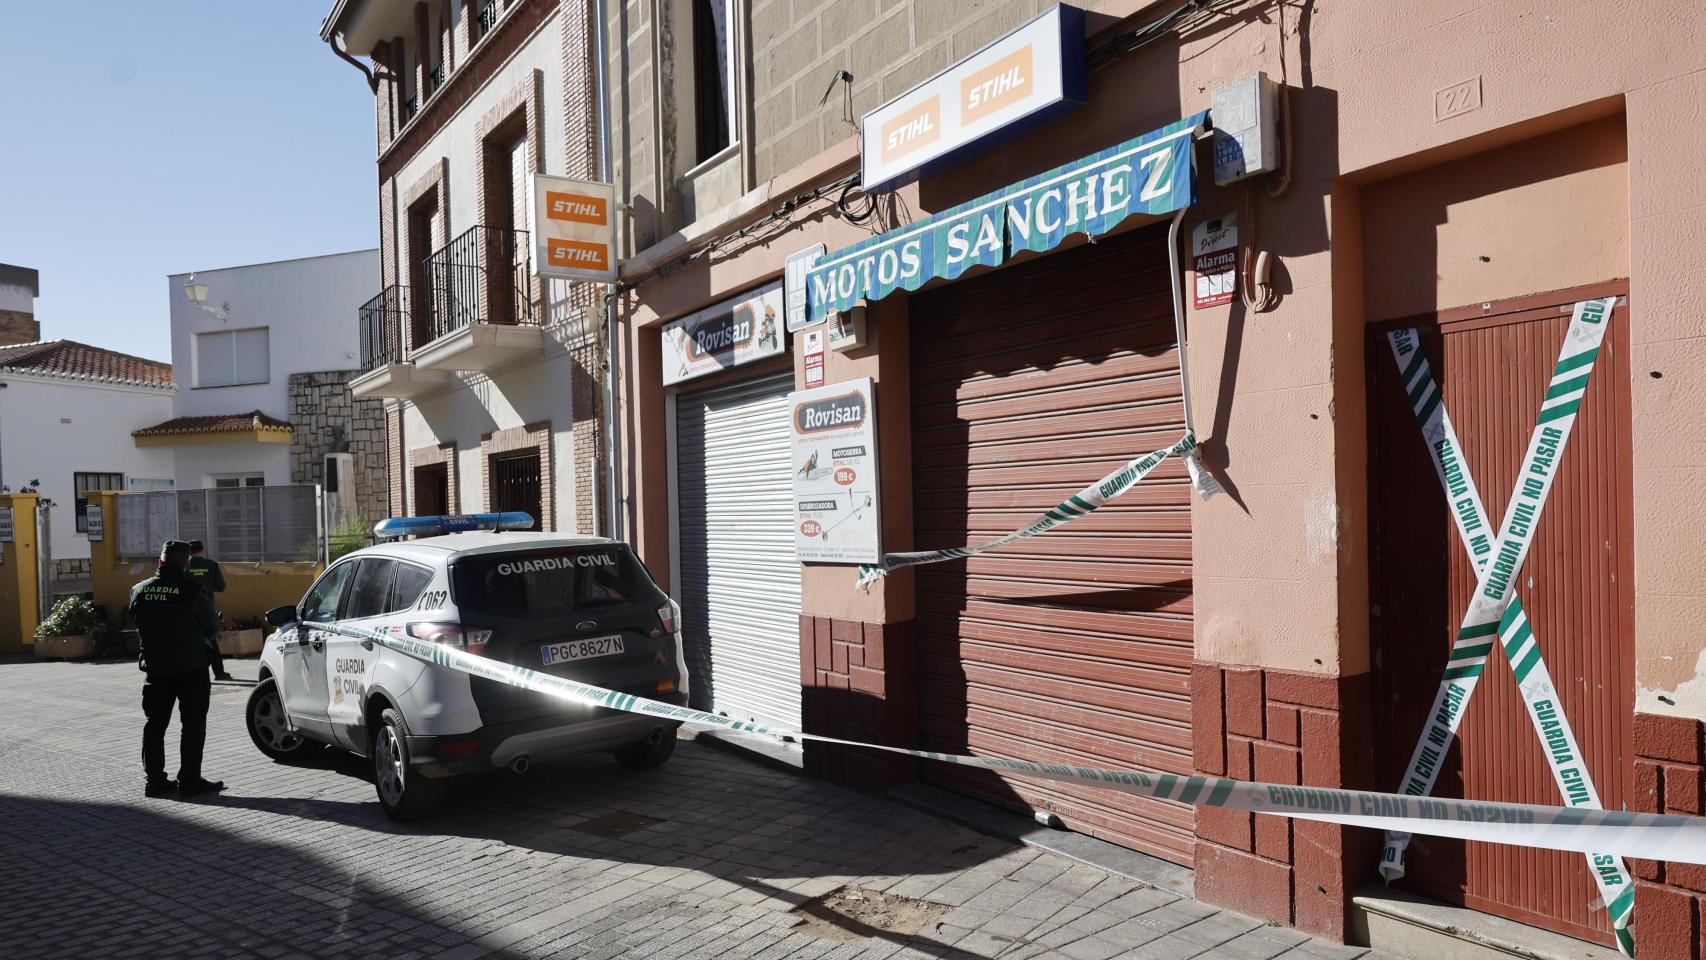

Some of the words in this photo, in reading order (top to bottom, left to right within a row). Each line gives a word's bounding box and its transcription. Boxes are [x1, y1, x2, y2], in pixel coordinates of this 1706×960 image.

[968, 65, 1025, 110] STIHL
[1444, 86, 1471, 114] 22
[887, 112, 934, 151] STIHL
[553, 200, 601, 217] STIHL
[813, 239, 921, 307] MOTOS
[946, 146, 1173, 265] SANCHEZ
[554, 247, 602, 263] STIHL
[1196, 252, 1235, 270] Alarma
[696, 320, 751, 355] Rovisan
[805, 403, 861, 429] Rovisan
[1529, 426, 1563, 476] PASAR
[837, 471, 848, 482] 199
[1099, 468, 1138, 499] GUARDIA
[1521, 477, 1545, 500] NO
[1433, 438, 1469, 498] GUARDIA
[1456, 497, 1482, 533] CIVIL
[1469, 534, 1491, 556] NO
[1508, 502, 1536, 538] CIVIL
[498, 557, 574, 576] GUARDIA
[577, 554, 615, 568] CIVIL
[1483, 539, 1523, 600] GUARDIA
[137, 586, 180, 595] GUARDIA
[144, 593, 168, 601] CIVIL
[425, 590, 447, 611] 062
[550, 644, 578, 662] PGC
[580, 640, 611, 657] 8627
[336, 659, 365, 674] GUARDIA
[344, 679, 361, 695] CIVIL
[1414, 746, 1440, 779] CIVIL
[1428, 724, 1448, 748] NO
[1445, 683, 1466, 727] PASAR
[1532, 699, 1574, 765] GUARDIA
[1559, 767, 1592, 806] CIVIL
[1592, 853, 1624, 886] SAR
